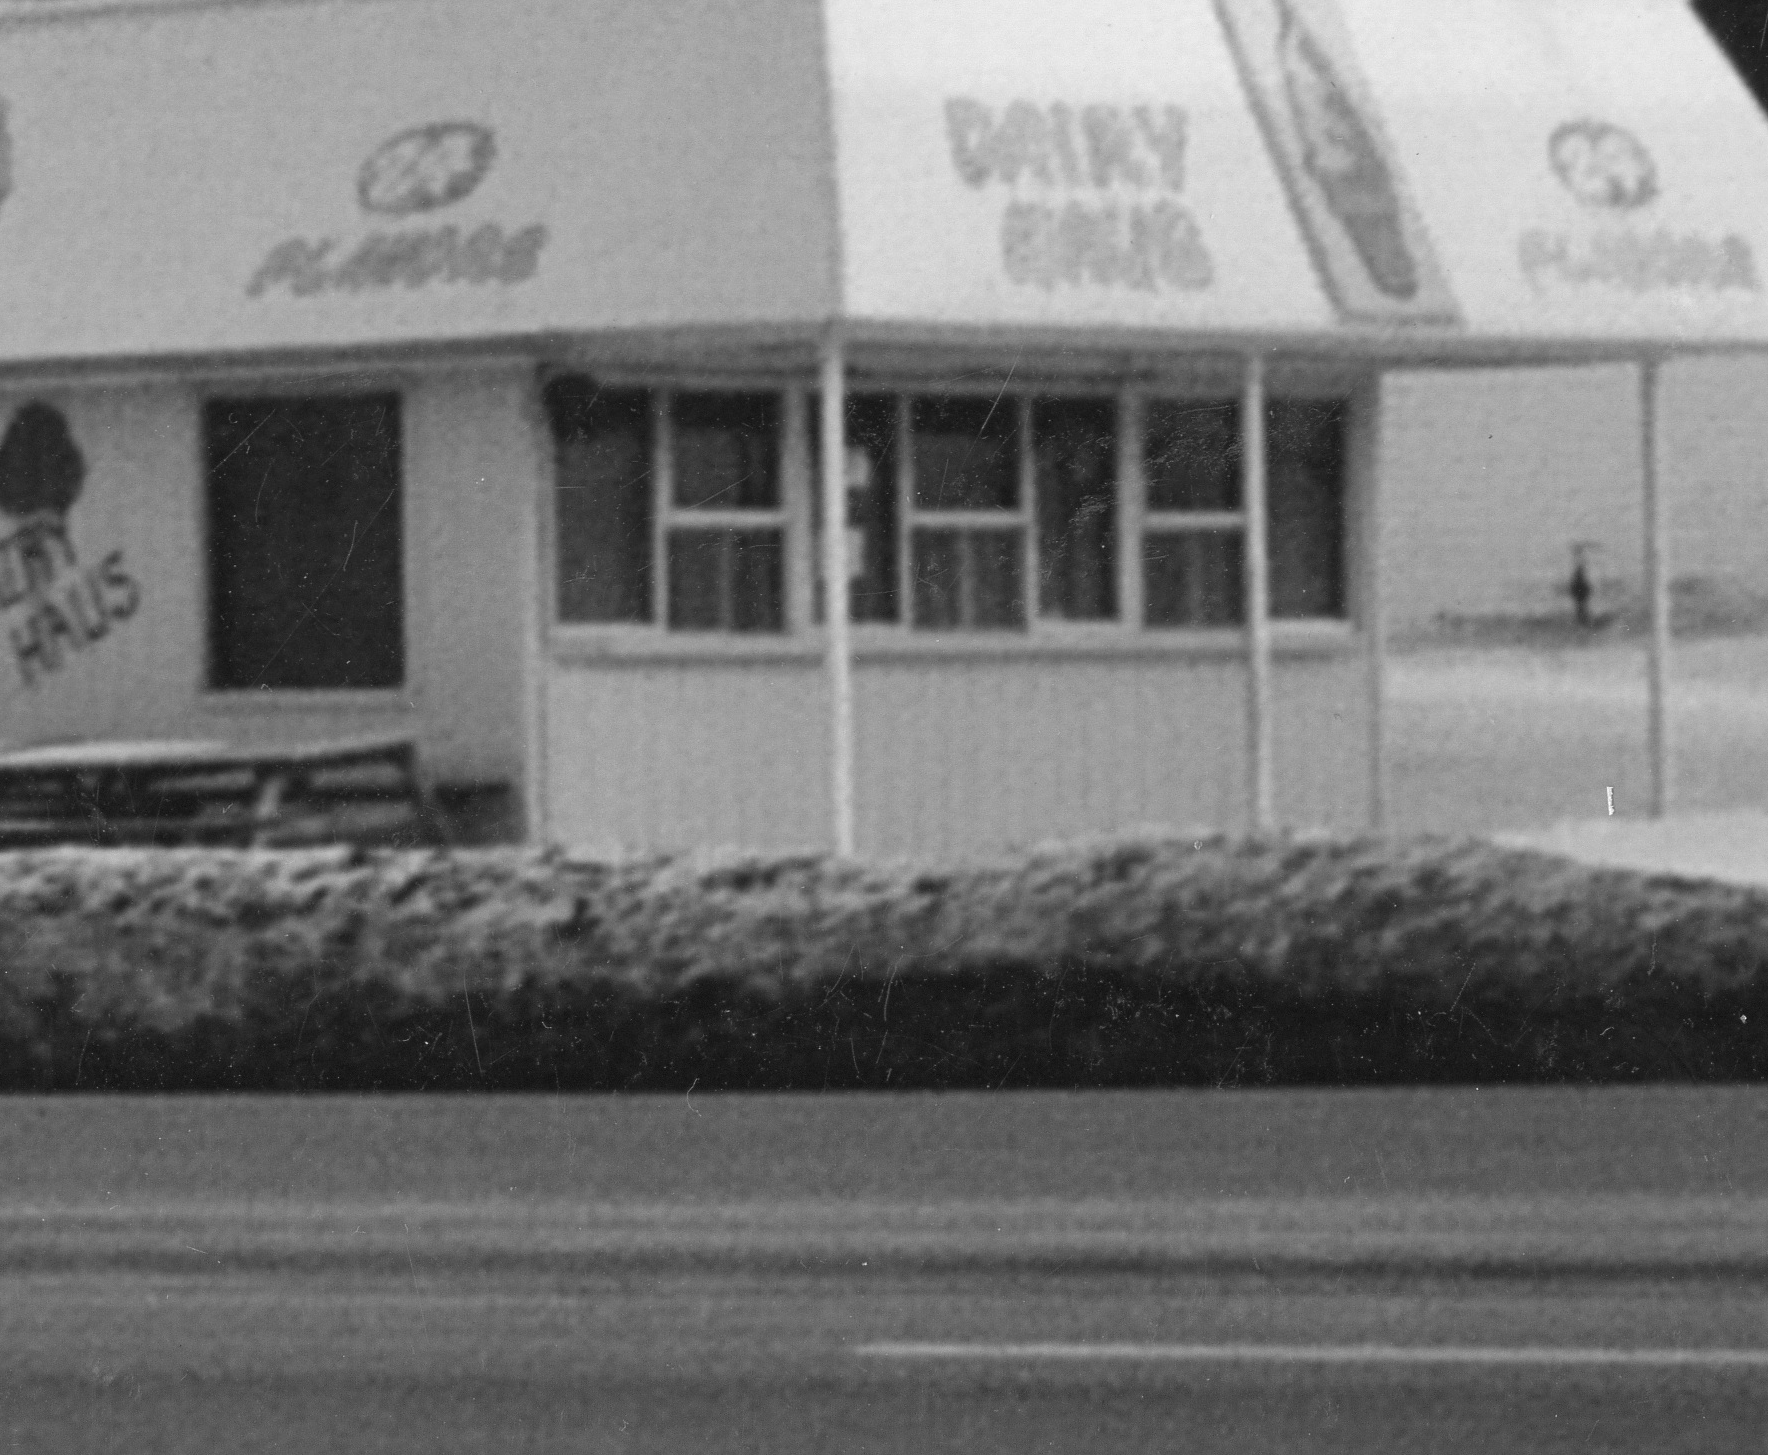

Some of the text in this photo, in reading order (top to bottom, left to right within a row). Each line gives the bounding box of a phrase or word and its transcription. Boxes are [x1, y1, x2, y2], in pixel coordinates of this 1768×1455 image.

[943, 97, 1190, 192] DAIRY
[246, 223, 548, 297] FLAVORS
[9, 548, 141, 685] HAUS
